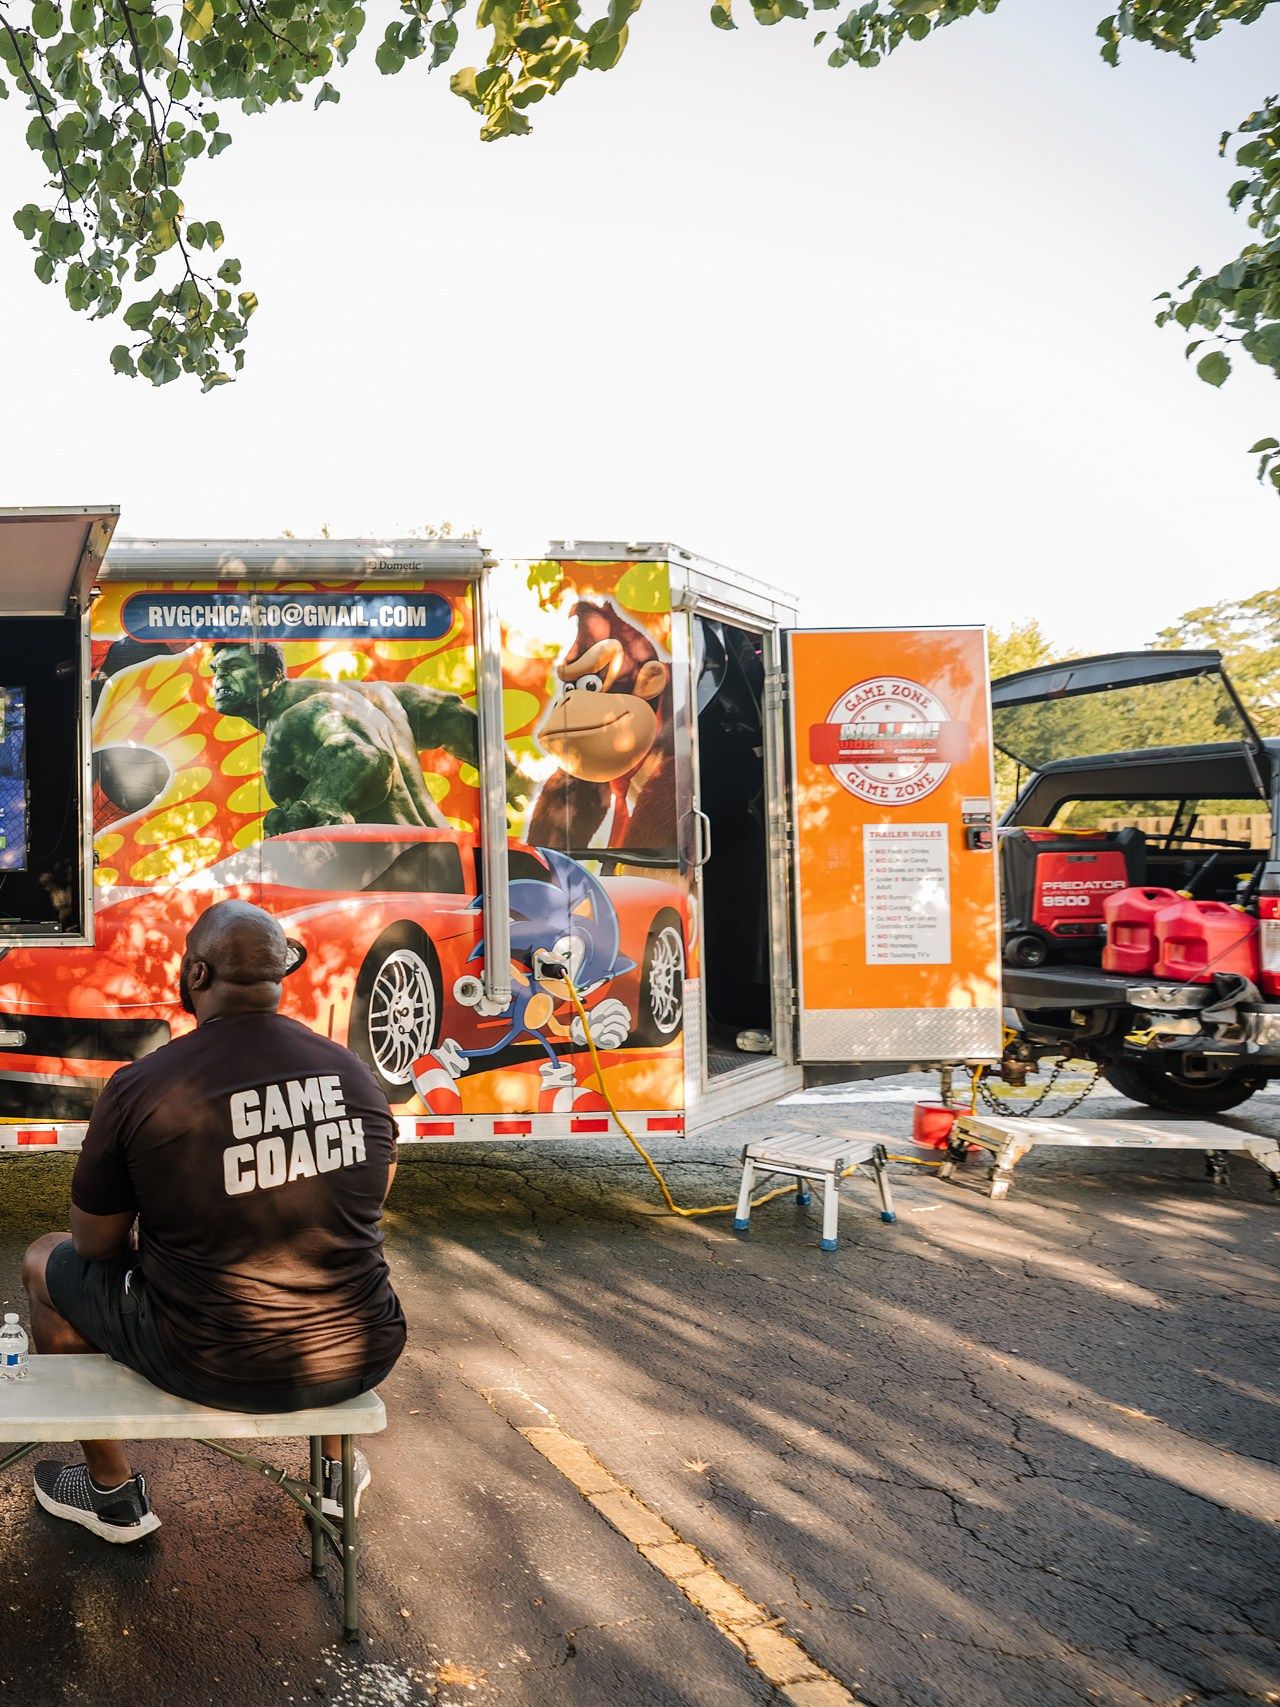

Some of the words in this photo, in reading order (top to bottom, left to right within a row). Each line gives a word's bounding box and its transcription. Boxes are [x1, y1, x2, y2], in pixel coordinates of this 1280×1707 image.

[378, 559, 421, 571] Dometic
[148, 603, 426, 628] RVGCHICAGO@GMAIL.COM
[845, 685, 886, 712] GAME
[891, 684, 932, 709] ZONE
[846, 771, 890, 798] GAME
[895, 772, 935, 798] ZONE
[911, 830, 942, 838] RULES
[1042, 880, 1126, 890] PREDATOR
[1042, 895, 1090, 907] 9500
[229, 1075, 347, 1140] GAME
[222, 1117, 367, 1196] COACH
